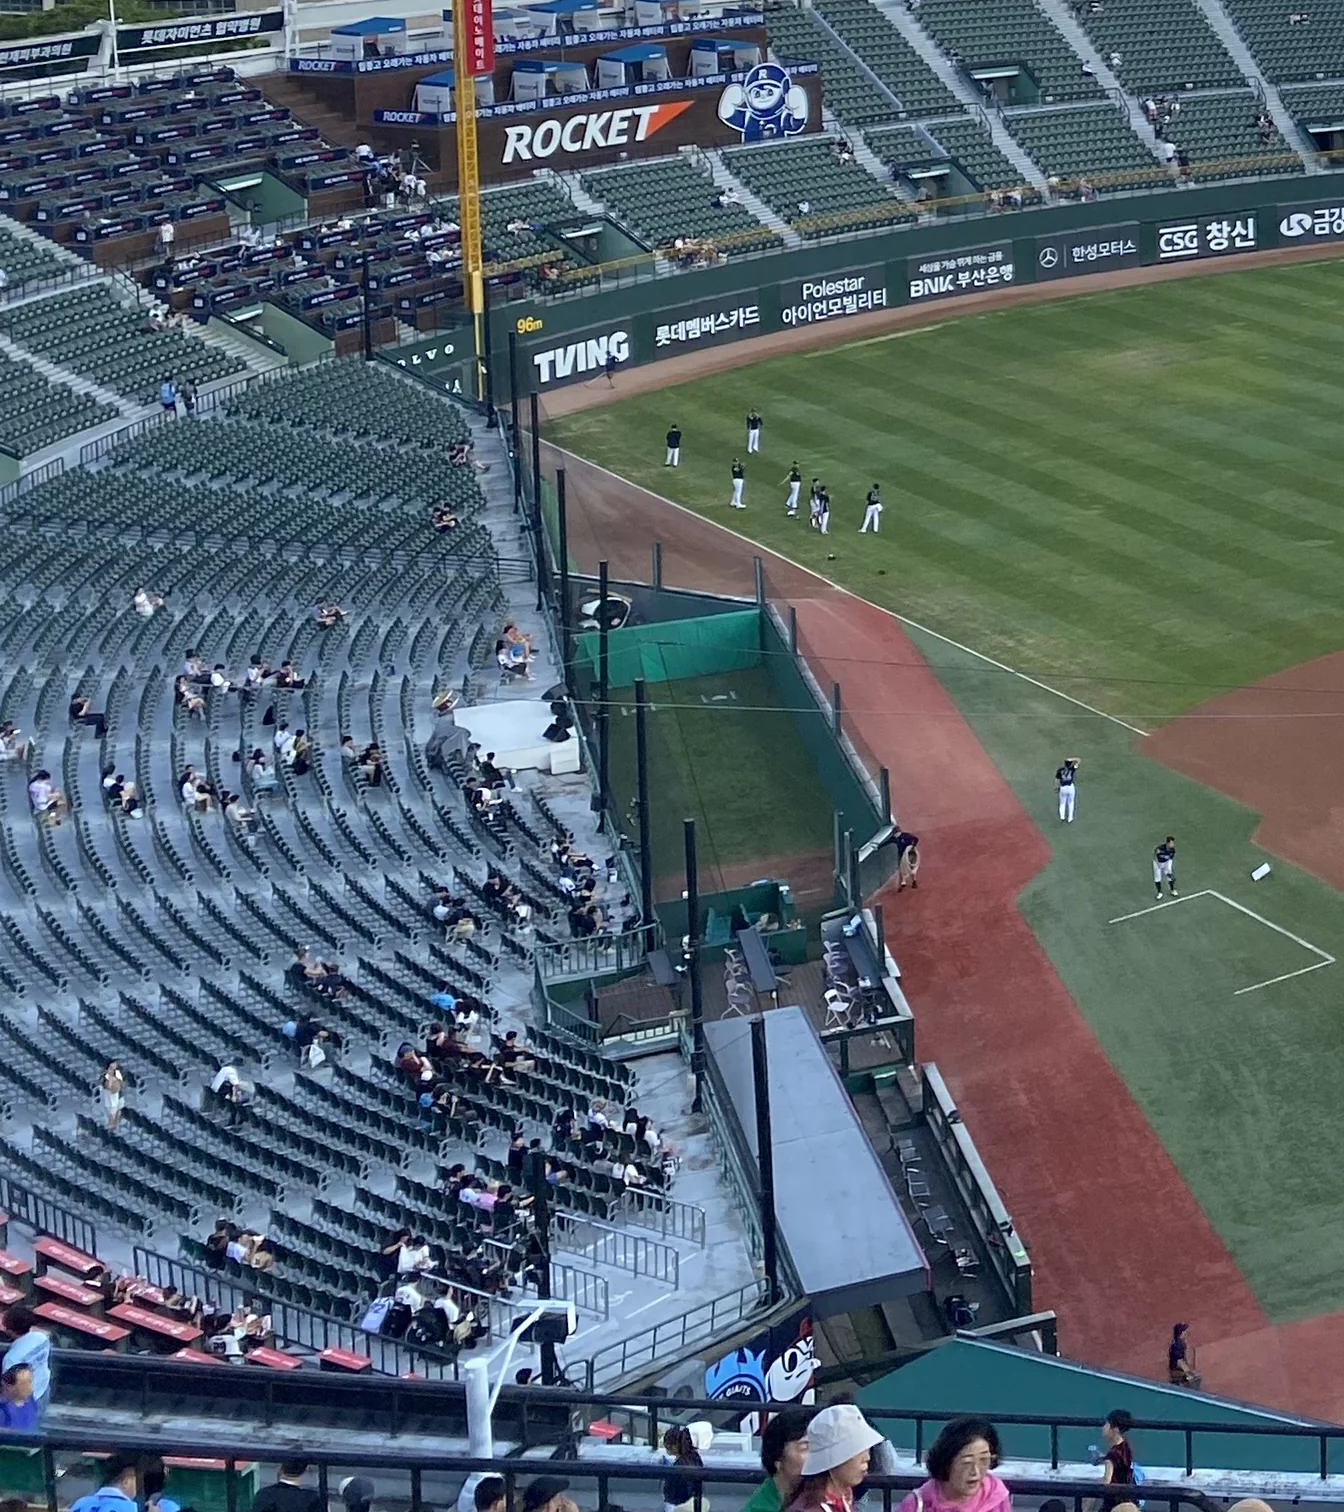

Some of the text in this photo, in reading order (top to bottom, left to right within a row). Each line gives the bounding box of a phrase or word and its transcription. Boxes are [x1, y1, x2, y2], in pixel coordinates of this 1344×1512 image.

[141, 24, 212, 45] 롯데자이언츠
[298, 61, 337, 72] ROCKET
[415, 53, 437, 65] 자동차
[382, 111, 421, 123] ROCKET
[502, 105, 660, 164] ROCKET
[1159, 218, 1256, 252] CSG 창신
[1071, 240, 1137, 263] 한성모터스
[802, 274, 865, 301] Polestar
[910, 264, 1014, 298] BNK 부산은행
[782, 287, 887, 326] 아이언모빌리티
[517, 316, 543, 335] 96m
[655, 305, 760, 348] 롯데멤버스카드
[534, 331, 629, 383] TVING
[725, 1384, 751, 1398] GIANTS
